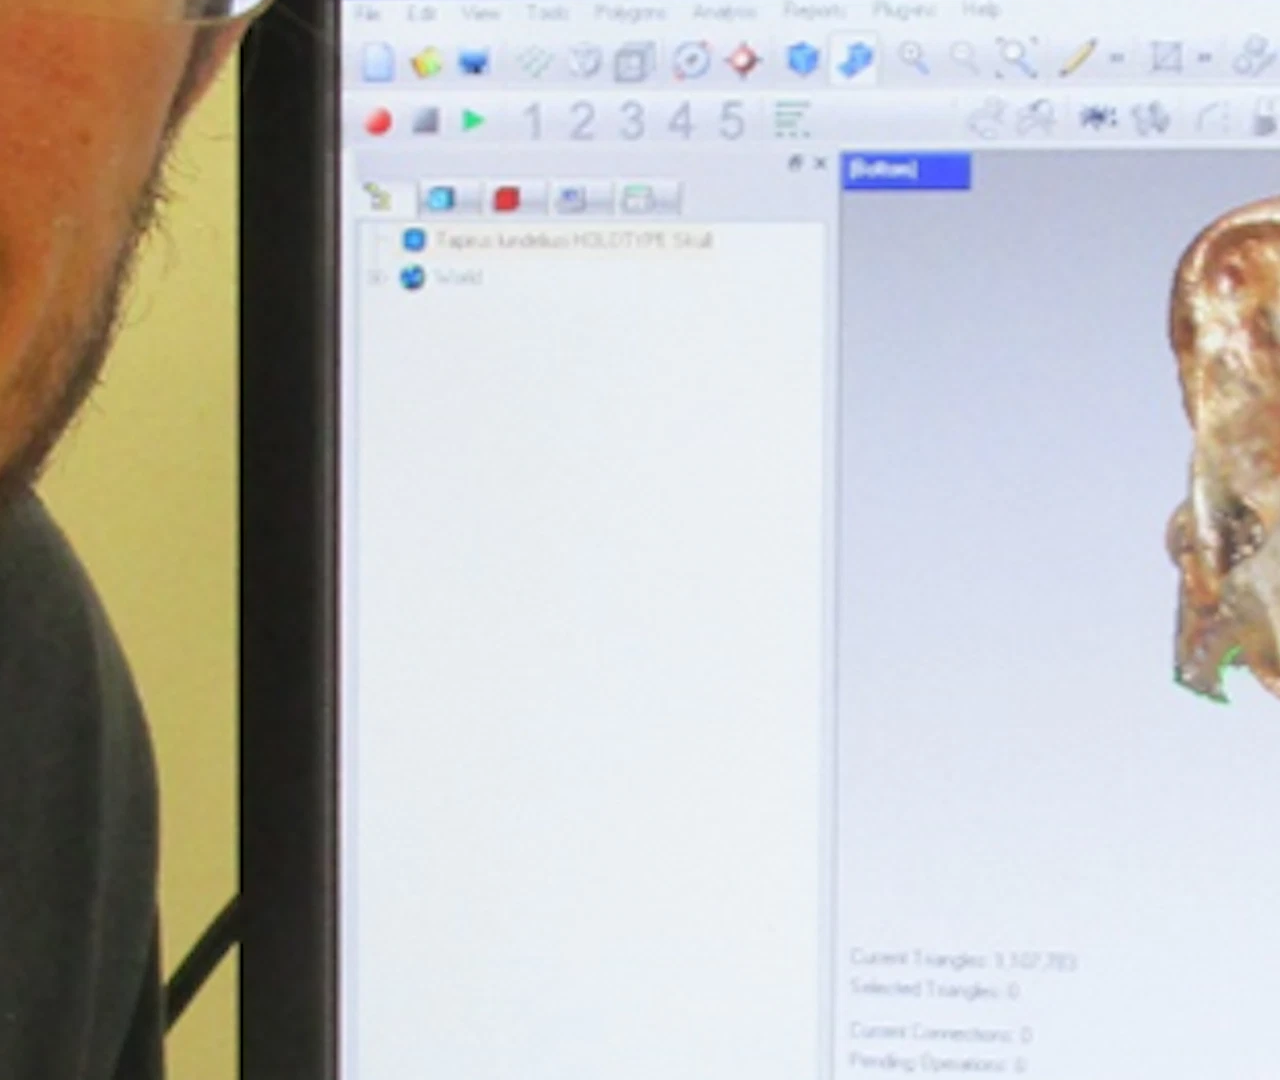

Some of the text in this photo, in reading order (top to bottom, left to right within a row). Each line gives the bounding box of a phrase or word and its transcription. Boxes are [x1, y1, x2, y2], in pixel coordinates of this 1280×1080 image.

[461, 2, 502, 20] View
[528, 2, 570, 20] Tools
[594, 1, 667, 24] Polygons
[692, 1, 758, 23] Analysis
[781, 0, 848, 22] Reports
[522, 99, 746, 141] 1 2 3 4 5
[573, 230, 666, 250] HOLOTYPE
[672, 230, 715, 250] Skull
[434, 266, 484, 287] World
[848, 946, 909, 966] Current
[848, 976, 922, 998] Selected
[848, 1020, 907, 1040] Current
[848, 1050, 917, 1074] Pending
